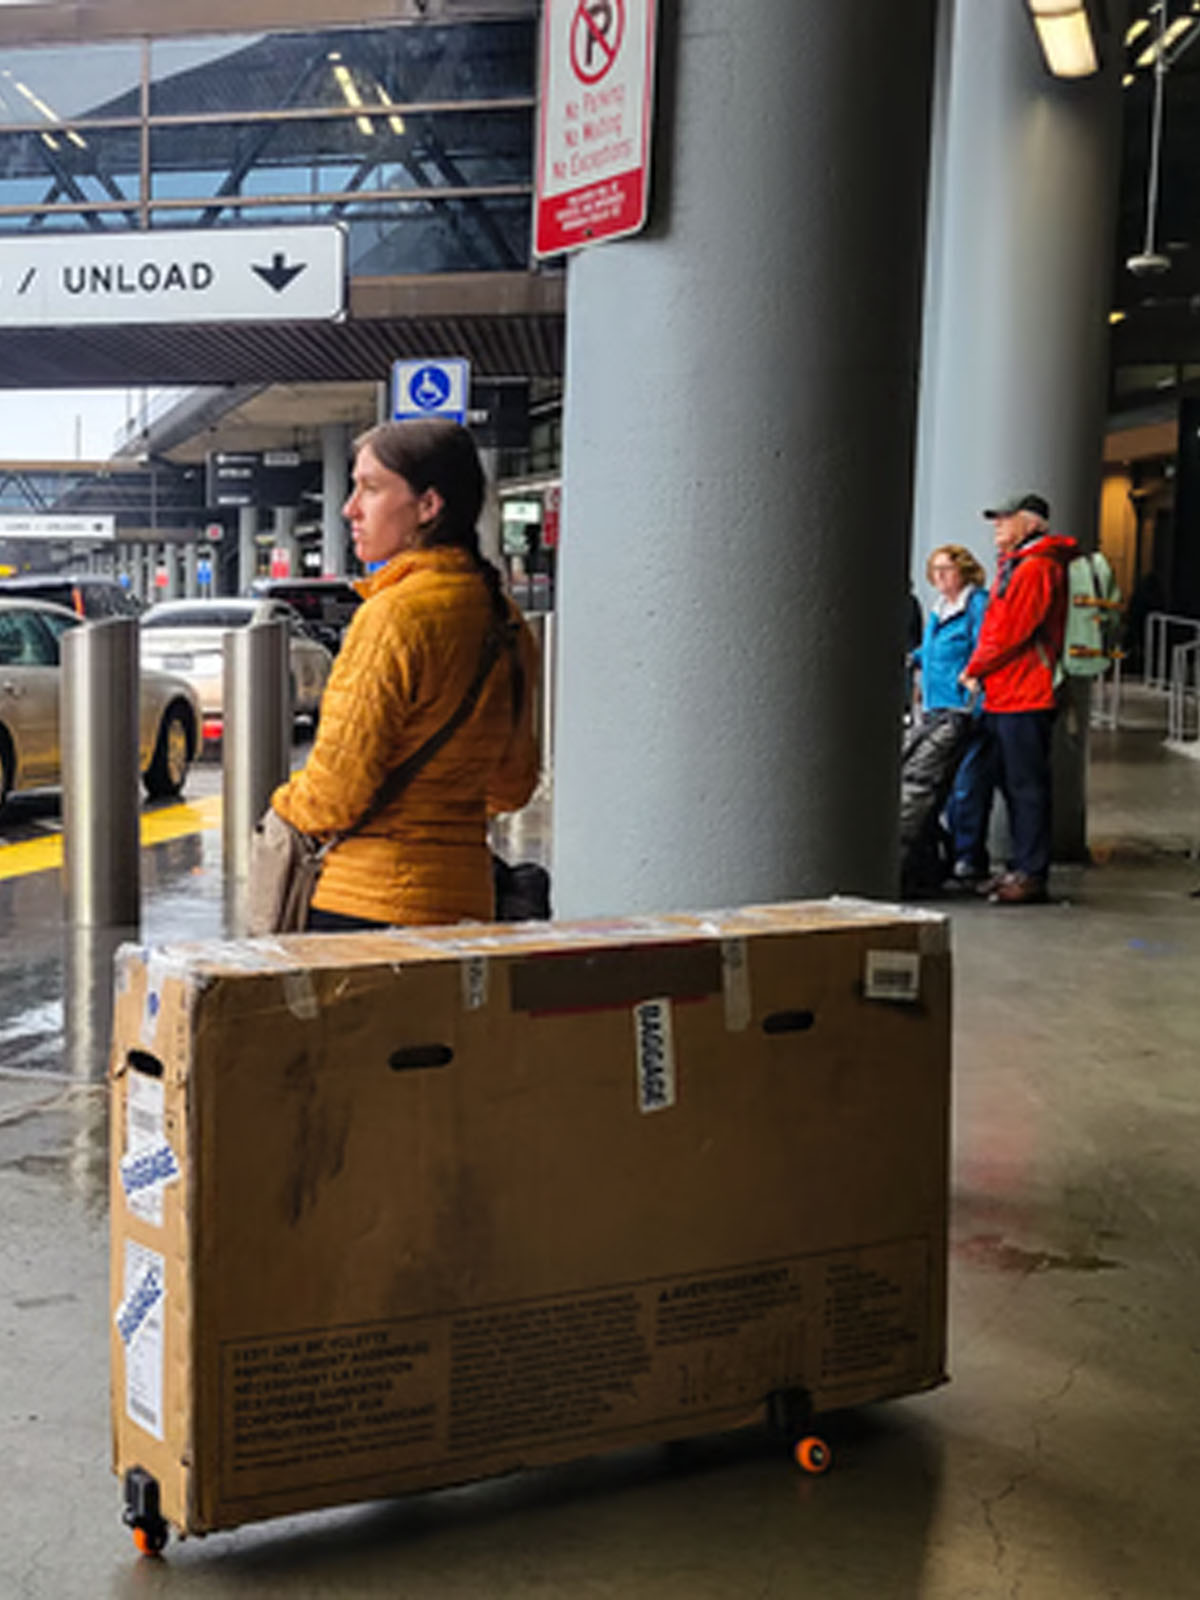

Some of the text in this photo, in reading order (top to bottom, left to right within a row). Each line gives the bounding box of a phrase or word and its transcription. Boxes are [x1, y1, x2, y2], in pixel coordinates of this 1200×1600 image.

[565, 84, 625, 120] No Parking
[564, 130, 578, 148] No
[553, 161, 567, 180] No
[63, 262, 214, 294] UNLOAD
[639, 1005, 667, 1106] BAGGAGE
